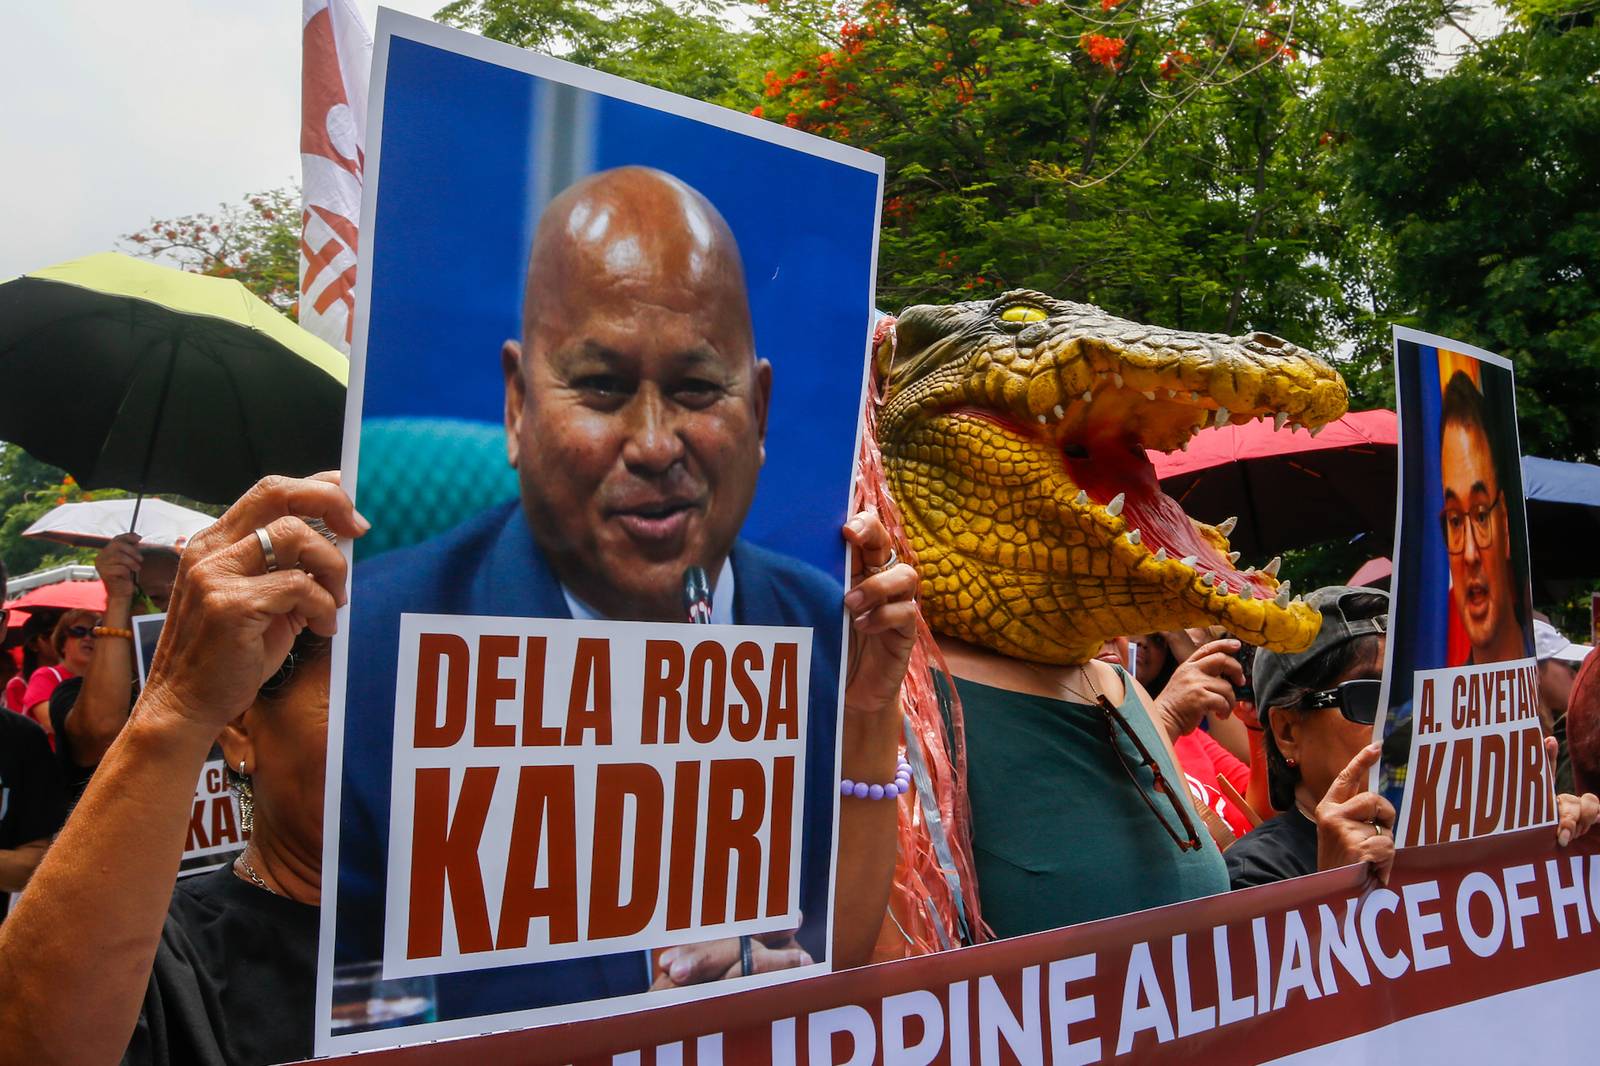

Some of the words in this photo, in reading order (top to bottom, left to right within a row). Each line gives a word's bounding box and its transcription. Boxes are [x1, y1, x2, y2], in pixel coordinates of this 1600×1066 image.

[413, 633, 613, 749] DELA
[640, 639, 799, 745] ROSA
[1418, 678, 1442, 735] A.
[406, 755, 796, 961] KADIRI
[1115, 879, 1451, 1057] ALLIANCE
[1456, 863, 1540, 958] OF
[1545, 853, 1600, 940] H
